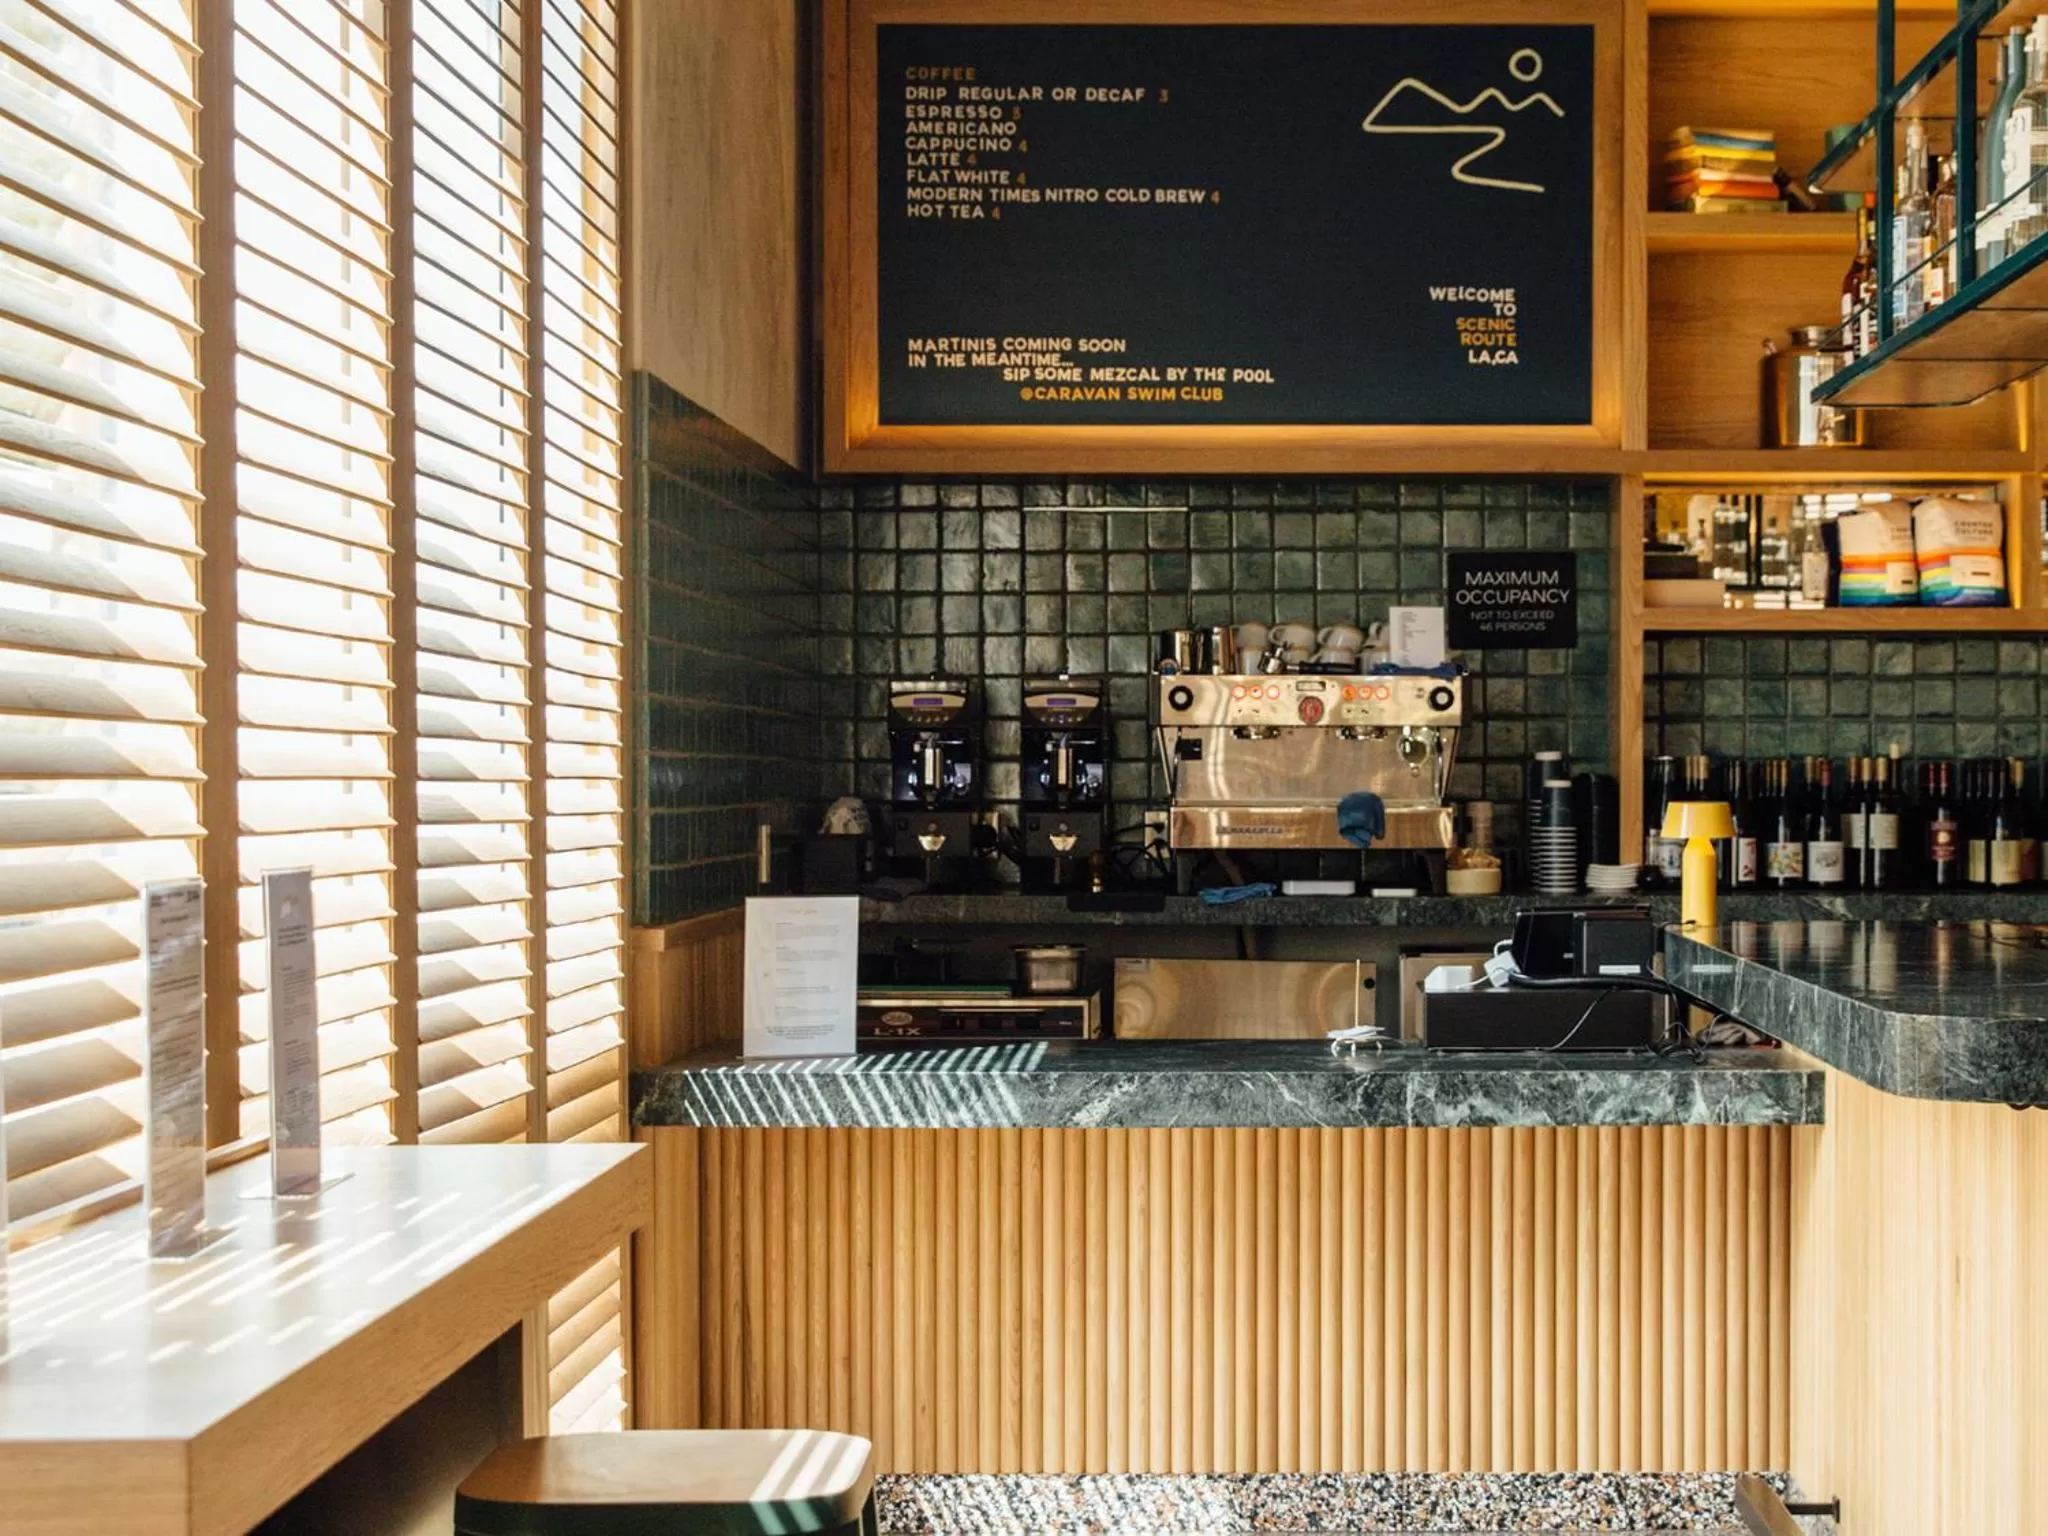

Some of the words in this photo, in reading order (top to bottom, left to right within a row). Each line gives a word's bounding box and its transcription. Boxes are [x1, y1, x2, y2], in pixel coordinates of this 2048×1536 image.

[905, 66, 976, 81] COFFEE
[905, 86, 947, 100] DRIP
[958, 86, 1043, 101] REGULAR
[1051, 87, 1077, 101] OR
[1085, 87, 1146, 103] DECAF
[905, 104, 1002, 120] ESPRESSO
[905, 121, 1017, 136] AMERICANO
[904, 136, 1012, 152] CAPPUCINO
[1019, 139, 1029, 153] 4
[907, 152, 961, 166] LATTE
[906, 168, 950, 183] FLAT
[954, 169, 1010, 184] WHITE
[1015, 172, 1026, 185] 4
[906, 187, 983, 201] MODERN
[988, 188, 1041, 203] TIMES
[1045, 188, 1099, 203] NITRO
[1105, 188, 1151, 202] COLD
[1155, 188, 1206, 204] BREW
[1210, 190, 1221, 205] 4
[907, 203, 945, 217] HOT
[949, 204, 985, 219] TEA
[1429, 286, 1516, 302] WELCOME
[1493, 303, 1517, 317] TO
[1455, 317, 1516, 331] SCENIC
[907, 337, 997, 352] MARTINIS
[1002, 336, 1073, 351] COMING
[1078, 338, 1127, 353] SOON
[1461, 332, 1517, 347] ROUTE
[907, 353, 927, 367] IN
[934, 353, 966, 367] THE
[1003, 367, 1030, 381] SIP
[1034, 367, 1083, 382] SOME
[1089, 367, 1161, 382] MEZCAL
[1166, 367, 1188, 381] BY
[1193, 367, 1227, 381] THE
[1232, 368, 1276, 383] POOL
[1127, 387, 1177, 401] SWIM
[1180, 386, 1224, 401] CLUB
[1465, 571, 1560, 586] MAXIMUM
[1455, 589, 1571, 605] OCCUPANCY
